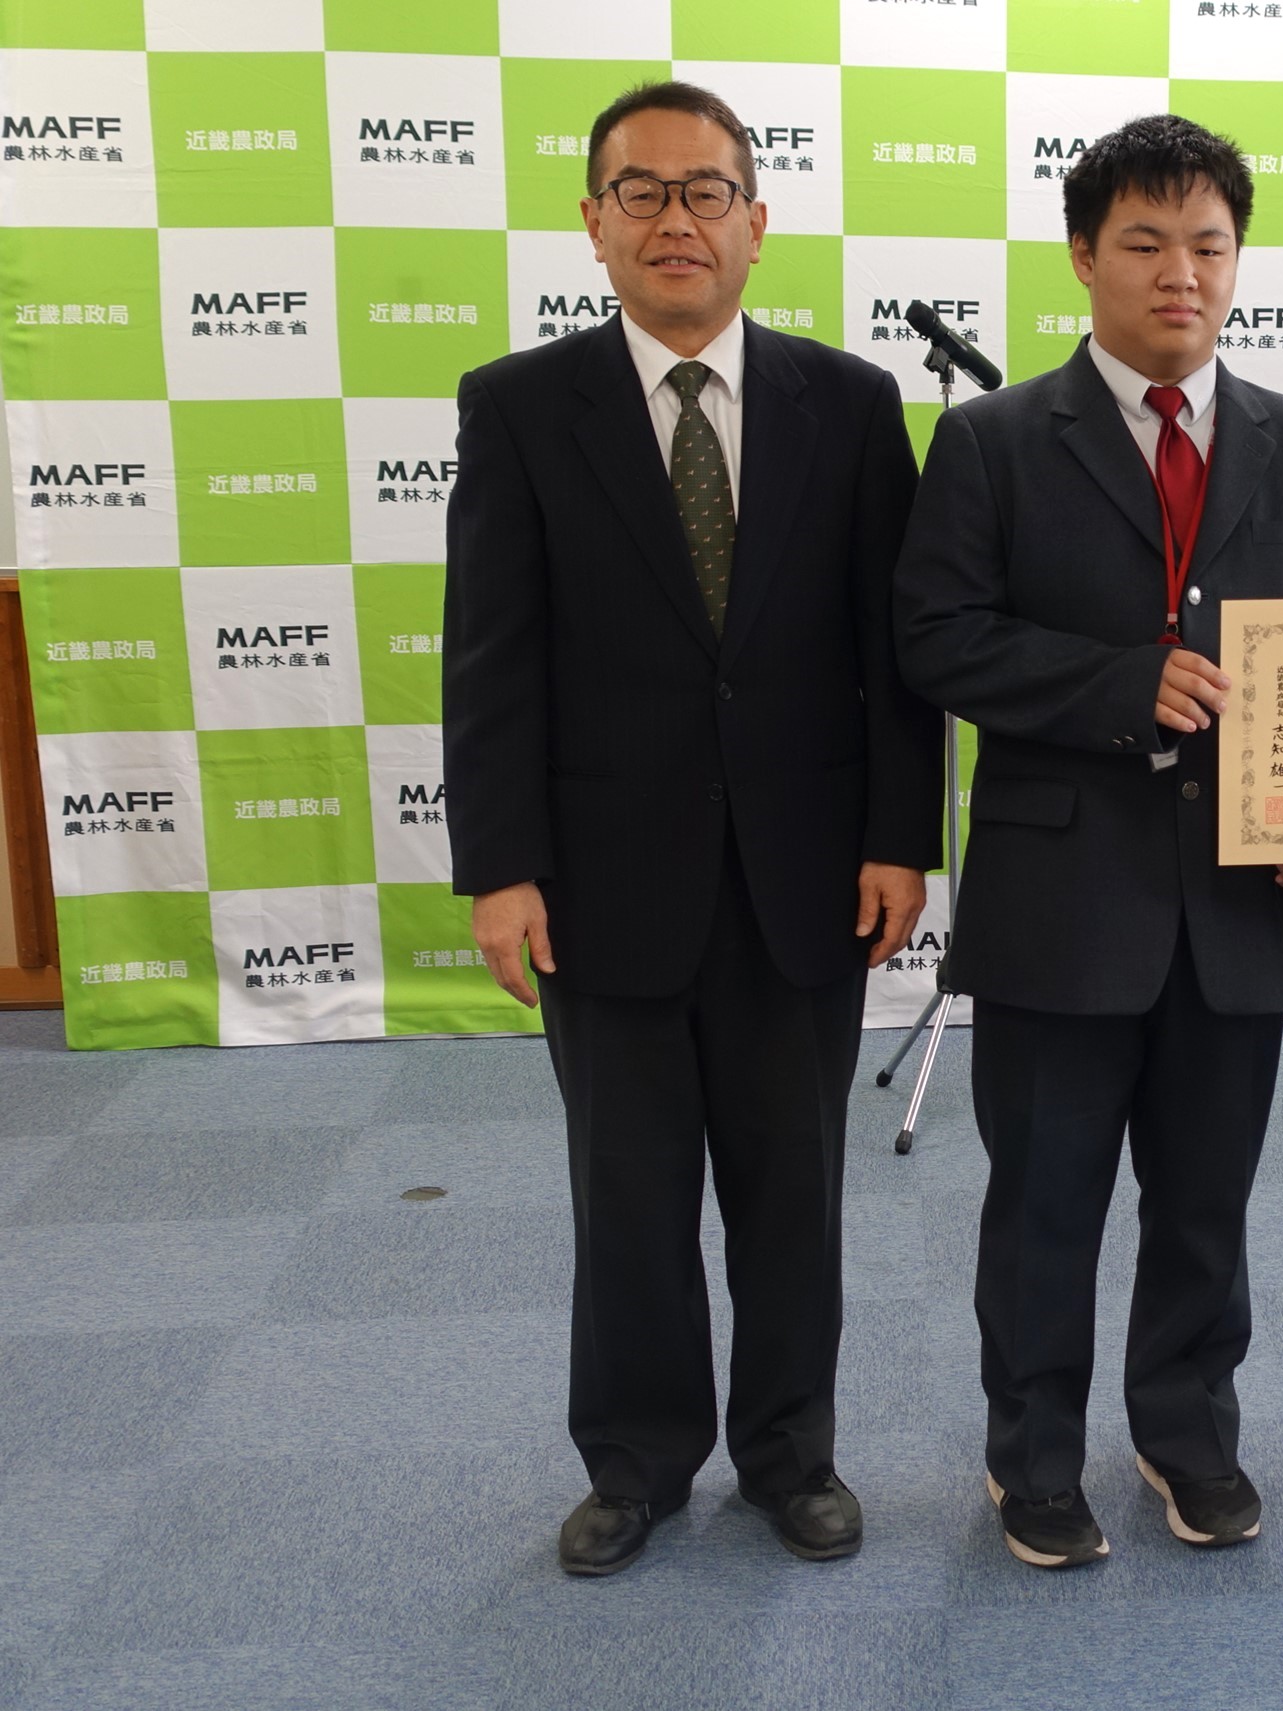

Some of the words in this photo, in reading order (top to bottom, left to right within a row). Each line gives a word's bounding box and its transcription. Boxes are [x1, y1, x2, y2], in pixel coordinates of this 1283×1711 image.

[2, 117, 120, 139] MAFF
[360, 119, 473, 142] MAFF
[186, 130, 297, 151] 近畿農政局
[4, 146, 122, 162] 農林水産省
[361, 147, 474, 165] 農林水産省
[873, 143, 976, 165] 近畿農政局
[192, 292, 306, 314] MAFF
[16, 304, 128, 325] 近畿農政局
[369, 303, 477, 325] 近畿農政局
[192, 320, 306, 336] 農林水産省
[872, 324, 978, 344] 農林省
[30, 464, 145, 486] MAFF
[208, 474, 316, 494] 近畿農政局
[31, 492, 145, 507] 農林水産省
[217, 625, 328, 648] MAFF
[47, 641, 156, 661] 近畿農政局
[219, 652, 330, 669] 農林水産省
[63, 792, 173, 815] MAFF
[235, 798, 340, 818] 近畿農政局
[65, 818, 174, 836] 農林水産省
[244, 943, 354, 970] MAFF
[81, 961, 187, 983] 近畿農政局
[243, 967, 355, 988] 農林水産省
